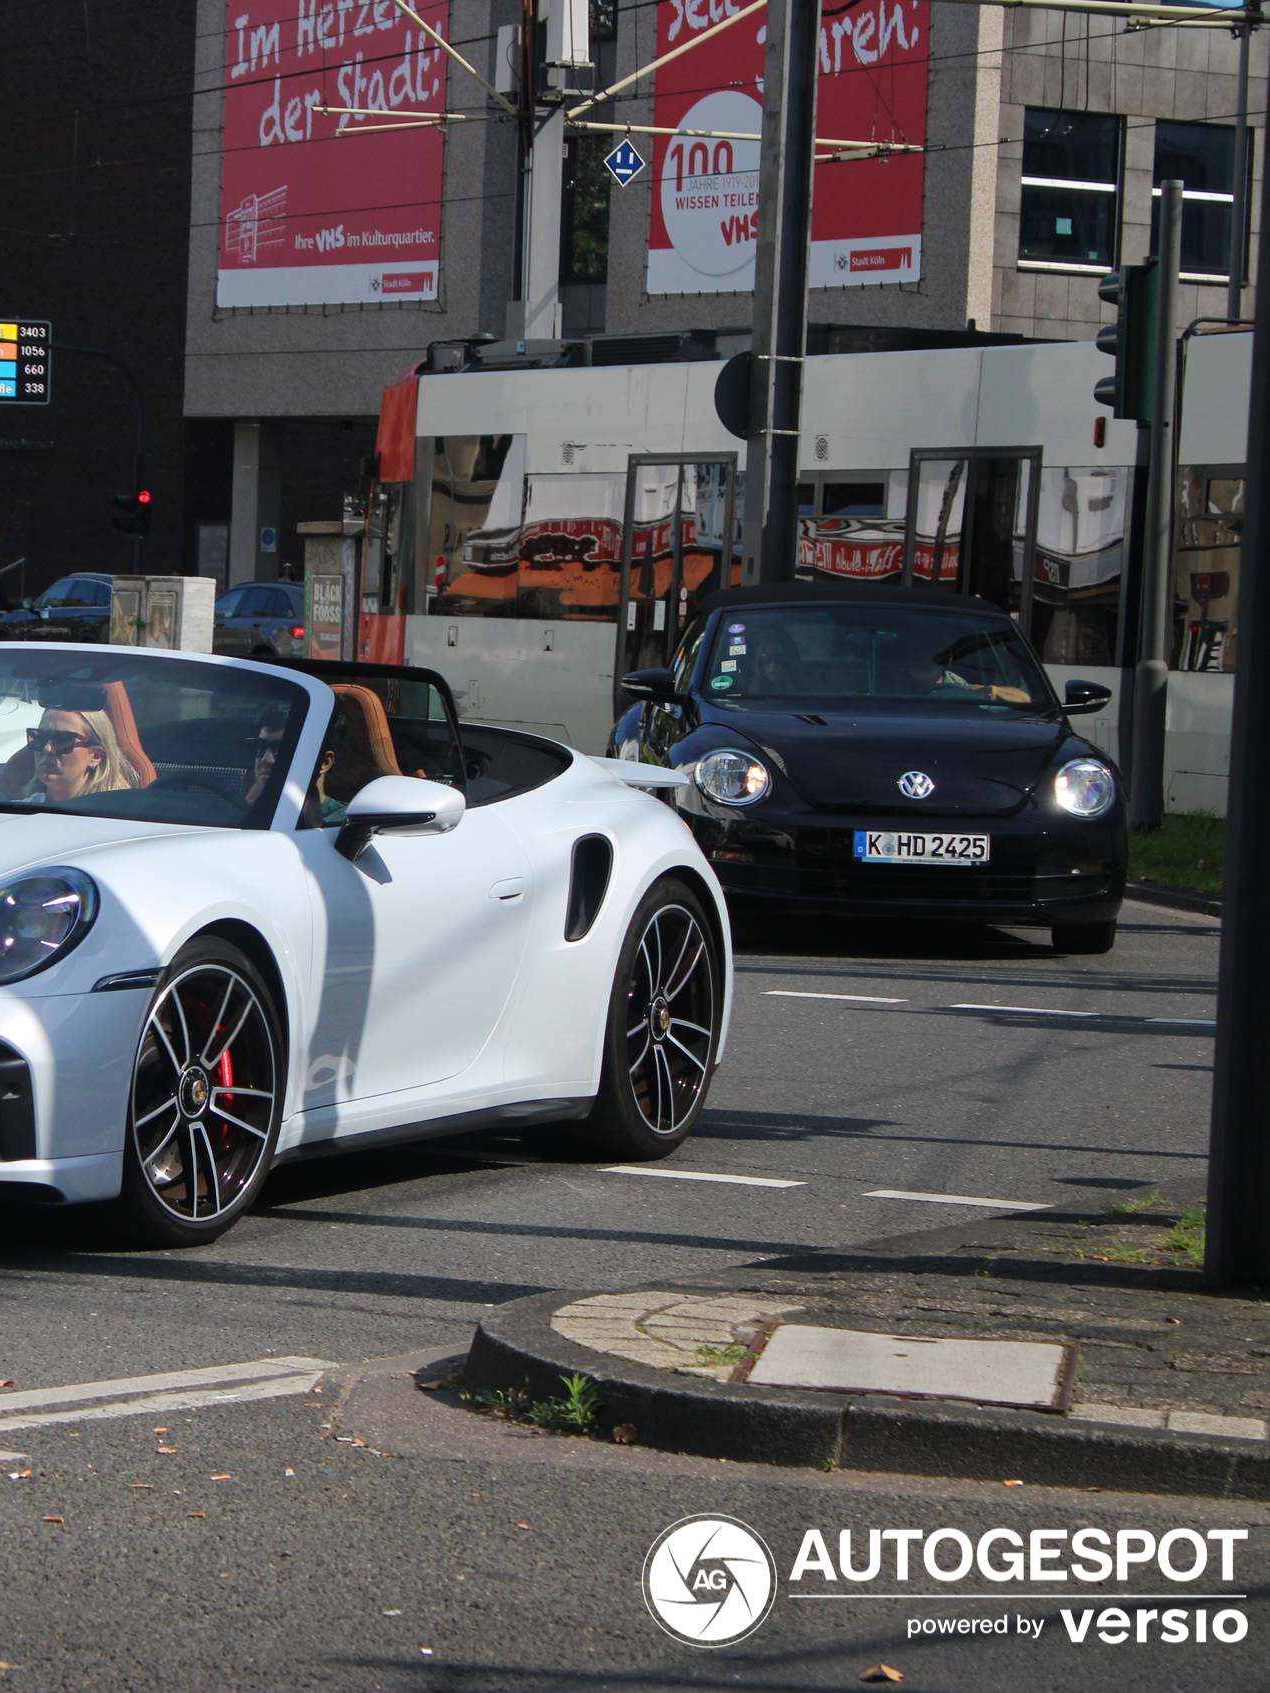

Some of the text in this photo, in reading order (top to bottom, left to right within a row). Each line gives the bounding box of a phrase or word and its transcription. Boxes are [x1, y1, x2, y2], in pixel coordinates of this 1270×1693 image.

[231, 14, 280, 79] Im
[260, 21, 442, 146] der Stadt!
[670, 140, 733, 192] 100
[687, 174, 760, 192] JAHRE 1919-201
[675, 195, 719, 210] WISSEN
[295, 224, 435, 253] Ihre VHS im Kulturquartier.
[851, 255, 885, 267] Stadt Köln
[383, 277, 412, 289] Stadt Köln
[19, 326, 46, 338] 3403
[21, 345, 46, 357] 1056
[24, 363, 45, 375] 660
[25, 382, 45, 394] 338
[868, 834, 881, 855] K
[898, 835, 926, 856] HD
[931, 837, 985, 858] 2425
